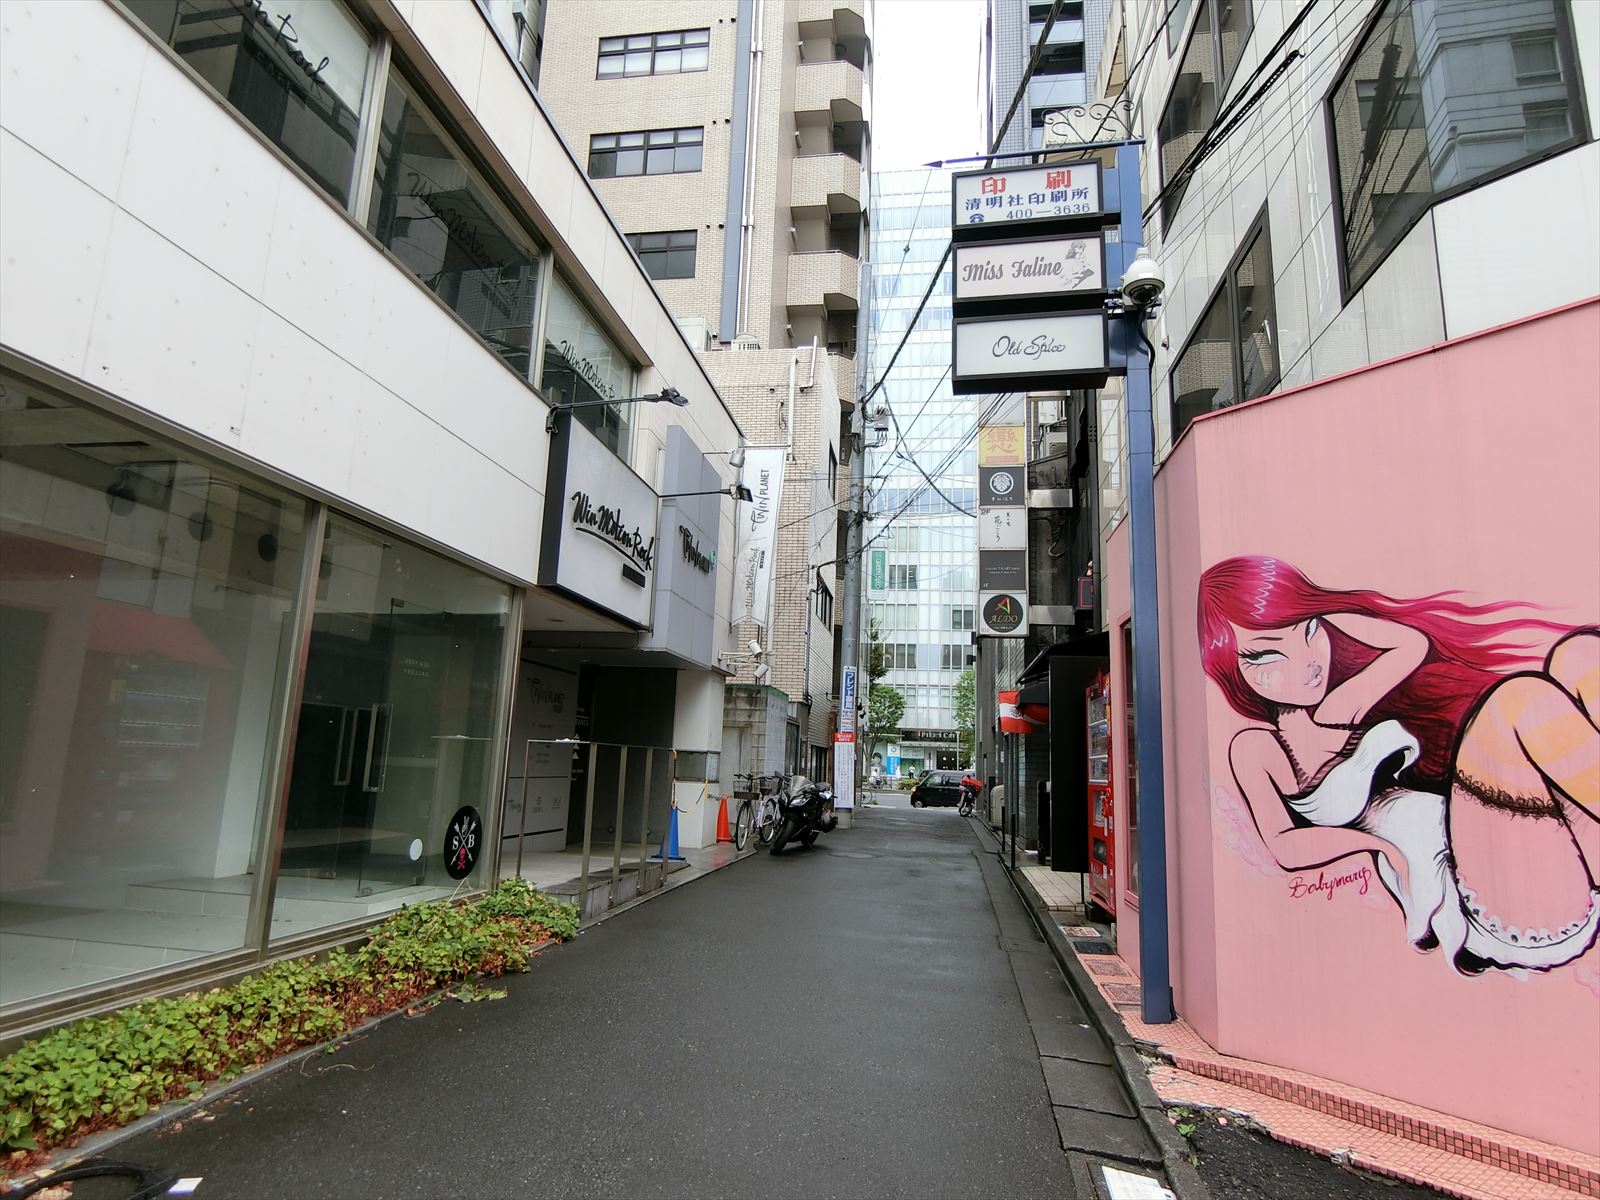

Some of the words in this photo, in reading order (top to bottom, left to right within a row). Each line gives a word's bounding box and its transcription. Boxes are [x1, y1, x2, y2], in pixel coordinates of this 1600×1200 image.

[981, 169, 1073, 196] 印刷
[965, 187, 1089, 211] 清明社印刷所
[962, 260, 1004, 282] Miss
[1011, 256, 1064, 279] Faline
[992, 335, 1022, 358] Old
[1022, 334, 1066, 361] Spice
[560, 340, 581, 371] Win
[582, 357, 609, 399] Motion
[759, 469, 770, 495] PLANET
[571, 491, 598, 525] Win
[597, 505, 634, 548] Motion
[632, 526, 655, 571] Rock
[1288, 869, 1372, 900] Babymary
